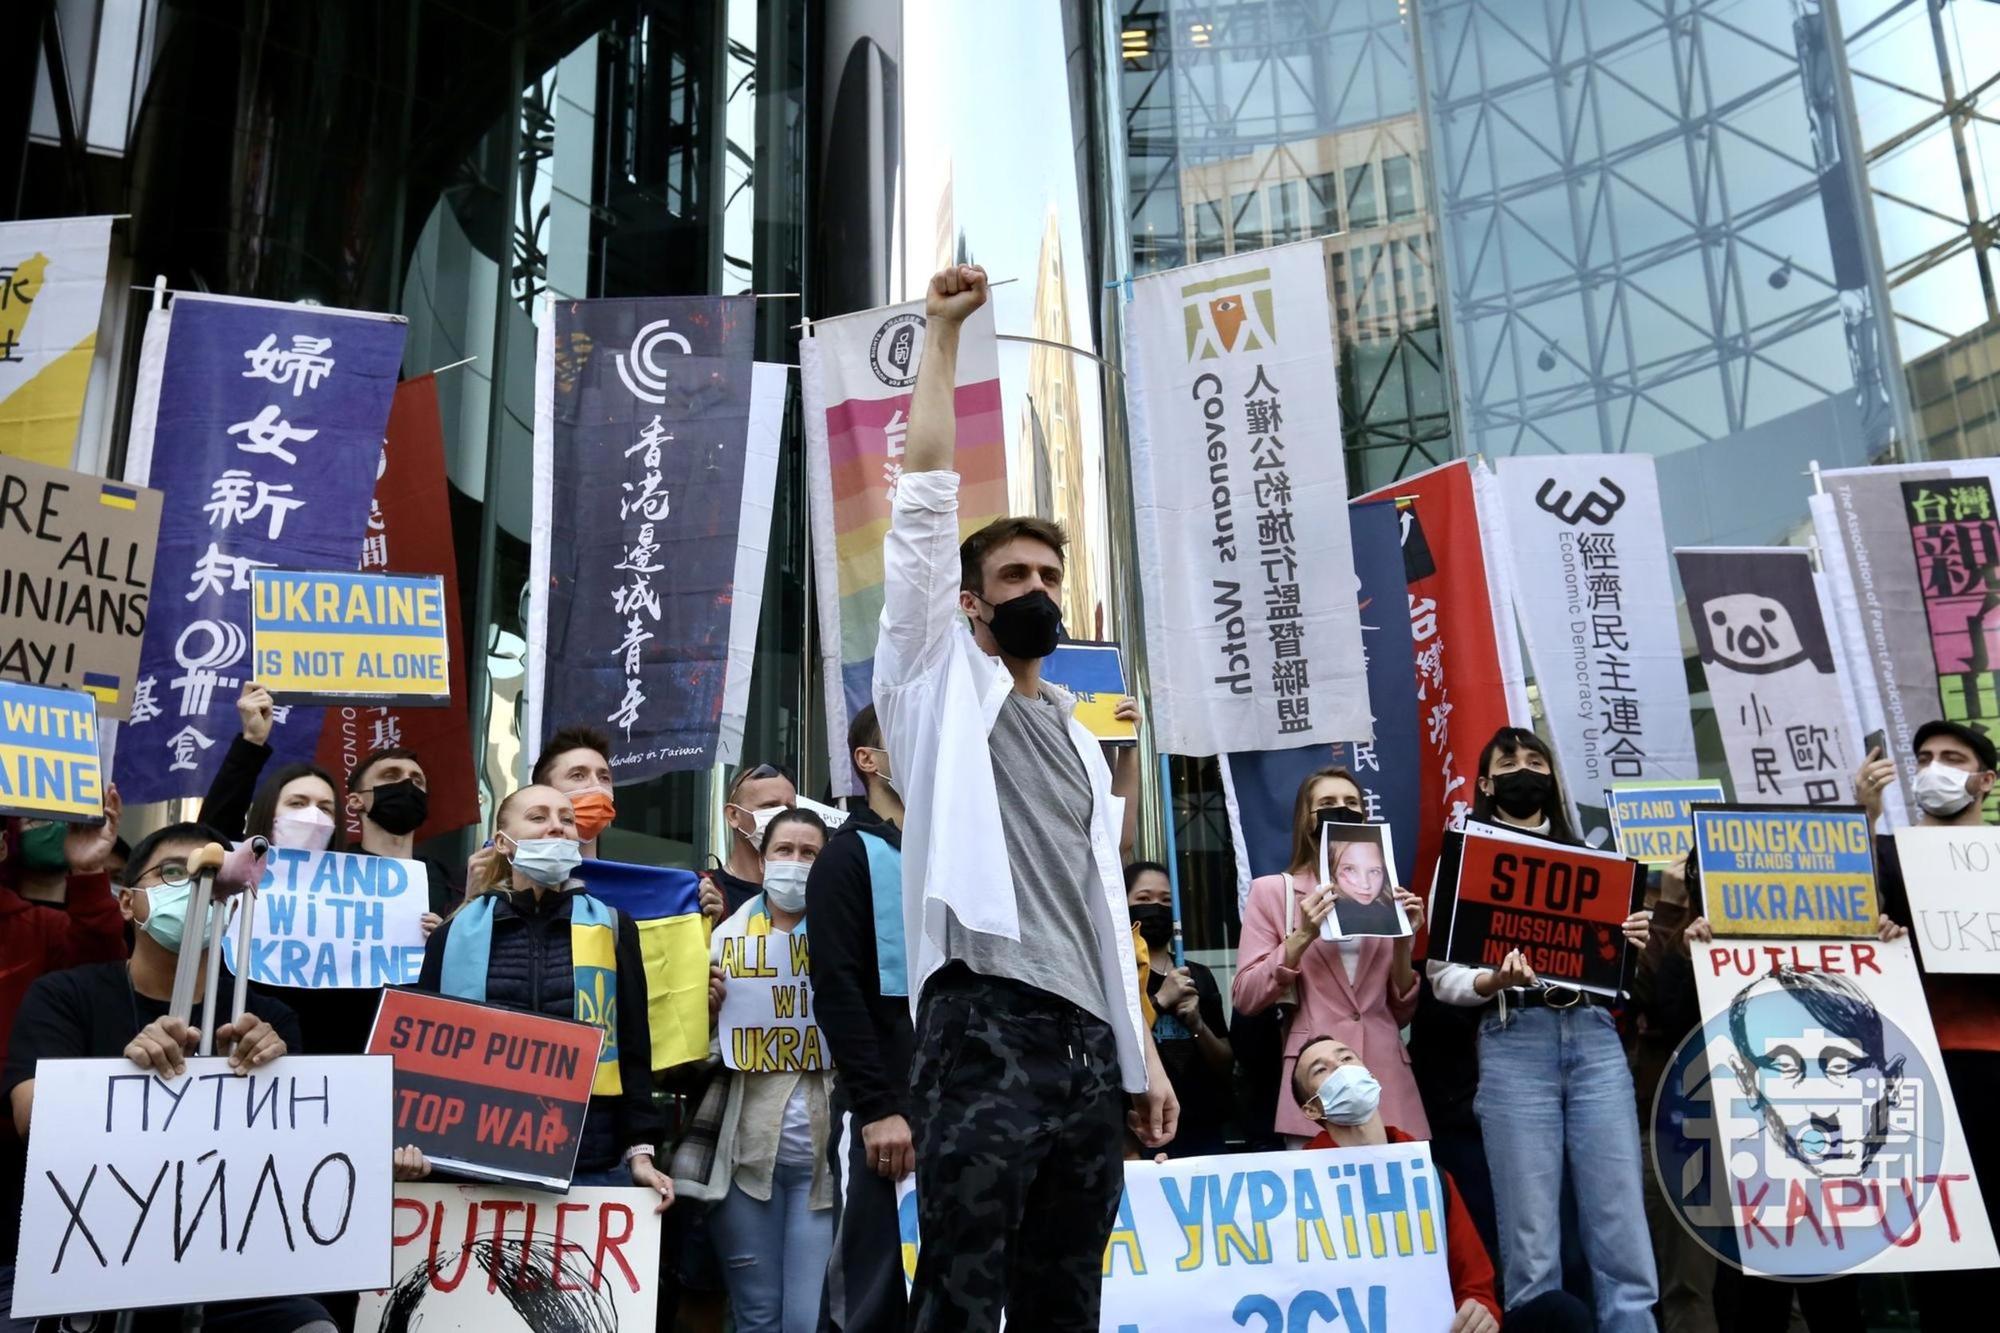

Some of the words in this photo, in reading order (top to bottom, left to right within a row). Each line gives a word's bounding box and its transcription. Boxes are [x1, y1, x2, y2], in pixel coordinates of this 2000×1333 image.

[185, 333, 336, 602] 婦女新知
[1837, 484, 1853, 509] The
[57, 531, 147, 588] ALL
[1558, 531, 1583, 615] Economic
[1846, 510, 1875, 590] Association
[255, 579, 441, 628] UKRAINE
[607, 412, 675, 744] 香港邊城青年
[1866, 591, 1883, 608] of
[1576, 531, 1647, 777] 經濟民主連合
[1870, 610, 1890, 662] Parent
[257, 650, 282, 676] IS
[293, 651, 345, 677] NOT
[356, 652, 444, 680] ALONE
[1570, 620, 1594, 722] Democracy
[3, 700, 95, 742] WITH
[1881, 661, 1914, 753] Participating
[1582, 728, 1600, 780] Union
[1618, 800, 1676, 820] STAND
[1624, 830, 1693, 857] UKRA
[1705, 819, 1868, 854] HONGKONG
[1735, 852, 1794, 870] STANDS
[1797, 853, 1836, 870] WITH
[1948, 840, 1990, 873] NO
[1490, 852, 1600, 914] STOP
[1721, 883, 1870, 922] UKRAINE
[1490, 910, 1584, 949] RUSSIAN
[720, 935, 778, 979] ALL
[1709, 943, 1883, 977] PUTLER
[389, 1015, 477, 1060] STOP
[483, 1031, 580, 1081] PUTIN
[731, 1025, 836, 1072] UKRA
[105, 1073, 330, 1133] ПУТИН
[394, 1088, 466, 1136] TOP
[476, 1102, 563, 1156] WAR
[45, 1148, 357, 1275] ХУЙЛО
[1736, 1173, 1970, 1251] KAPUT
